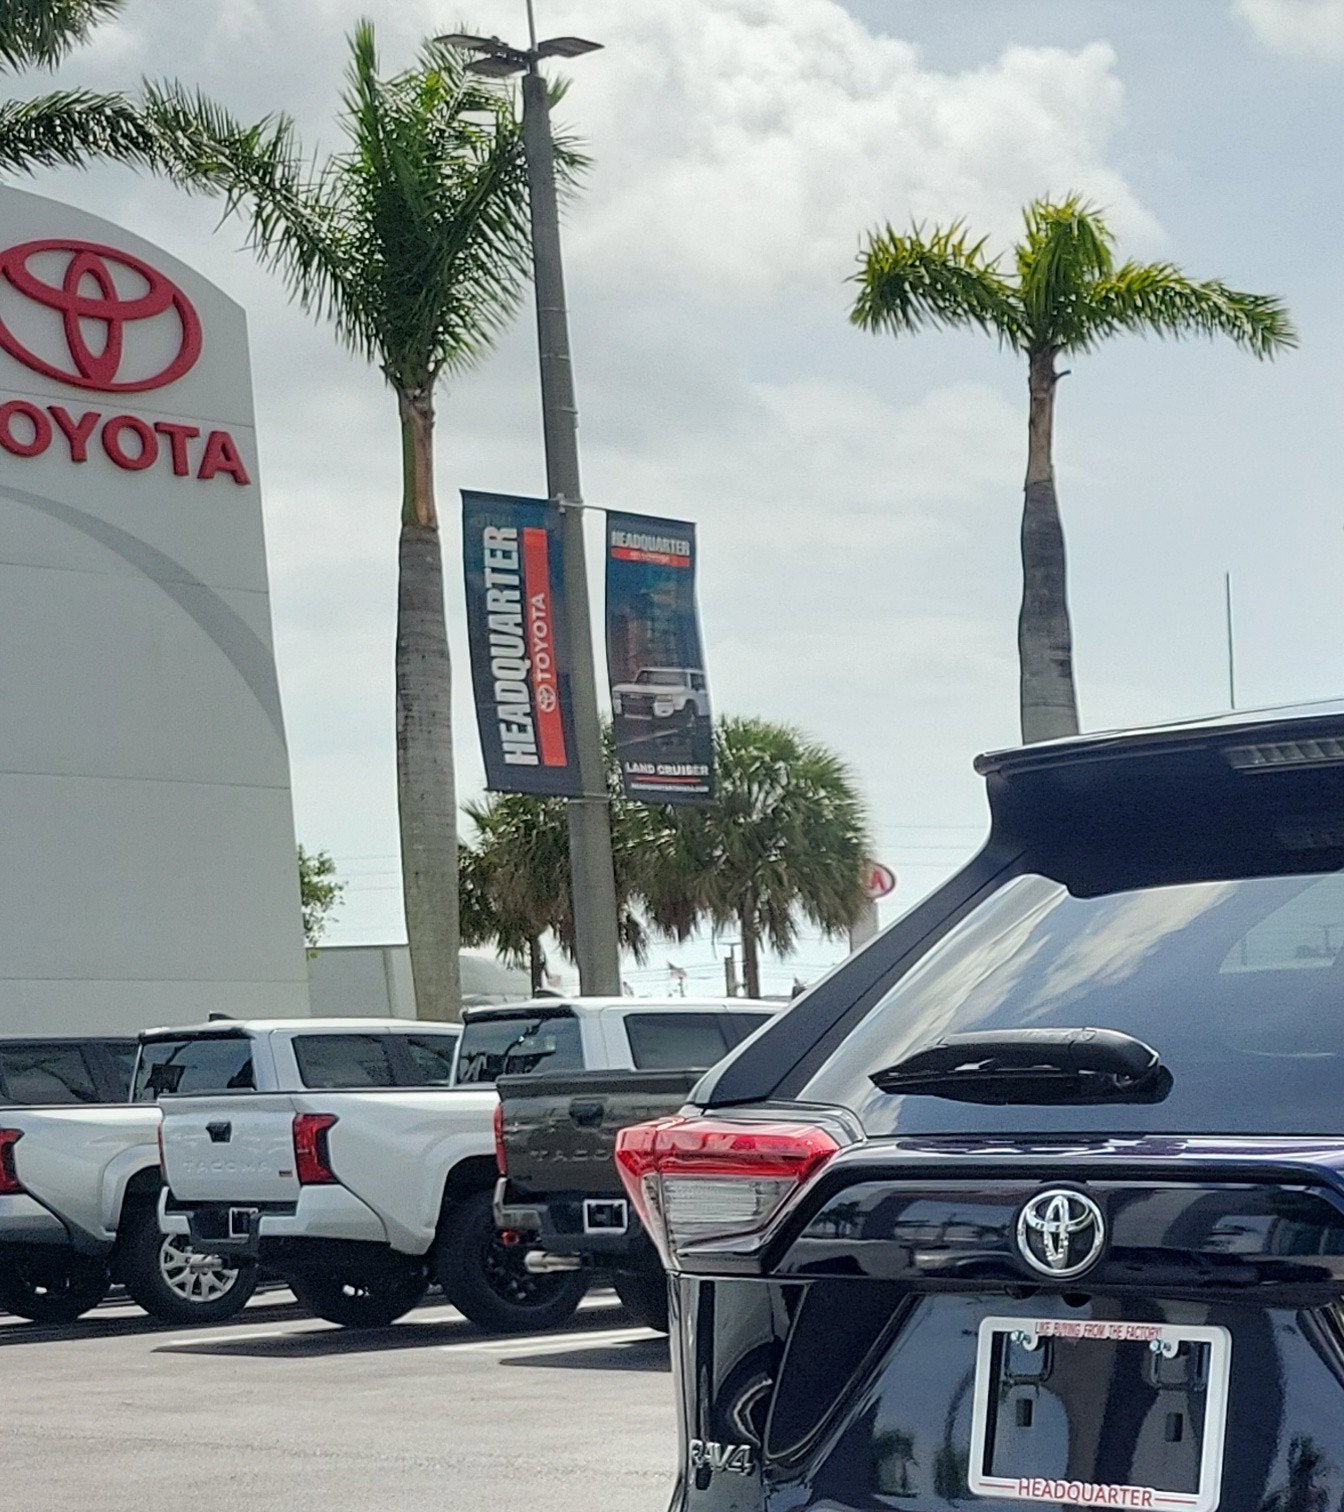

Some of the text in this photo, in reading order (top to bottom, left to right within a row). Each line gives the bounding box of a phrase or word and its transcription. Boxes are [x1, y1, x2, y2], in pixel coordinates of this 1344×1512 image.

[0, 400, 251, 486] OYOTA
[484, 526, 540, 766] HEADQUARTER
[531, 593, 552, 682] TOYOTA
[625, 762, 709, 776] LAND CRUISER
[1084, 1324, 1105, 1338] FROM
[1109, 1325, 1123, 1339] THE
[690, 1439, 752, 1476] RAV4
[1018, 1480, 1152, 1507] HEADQUARTER
